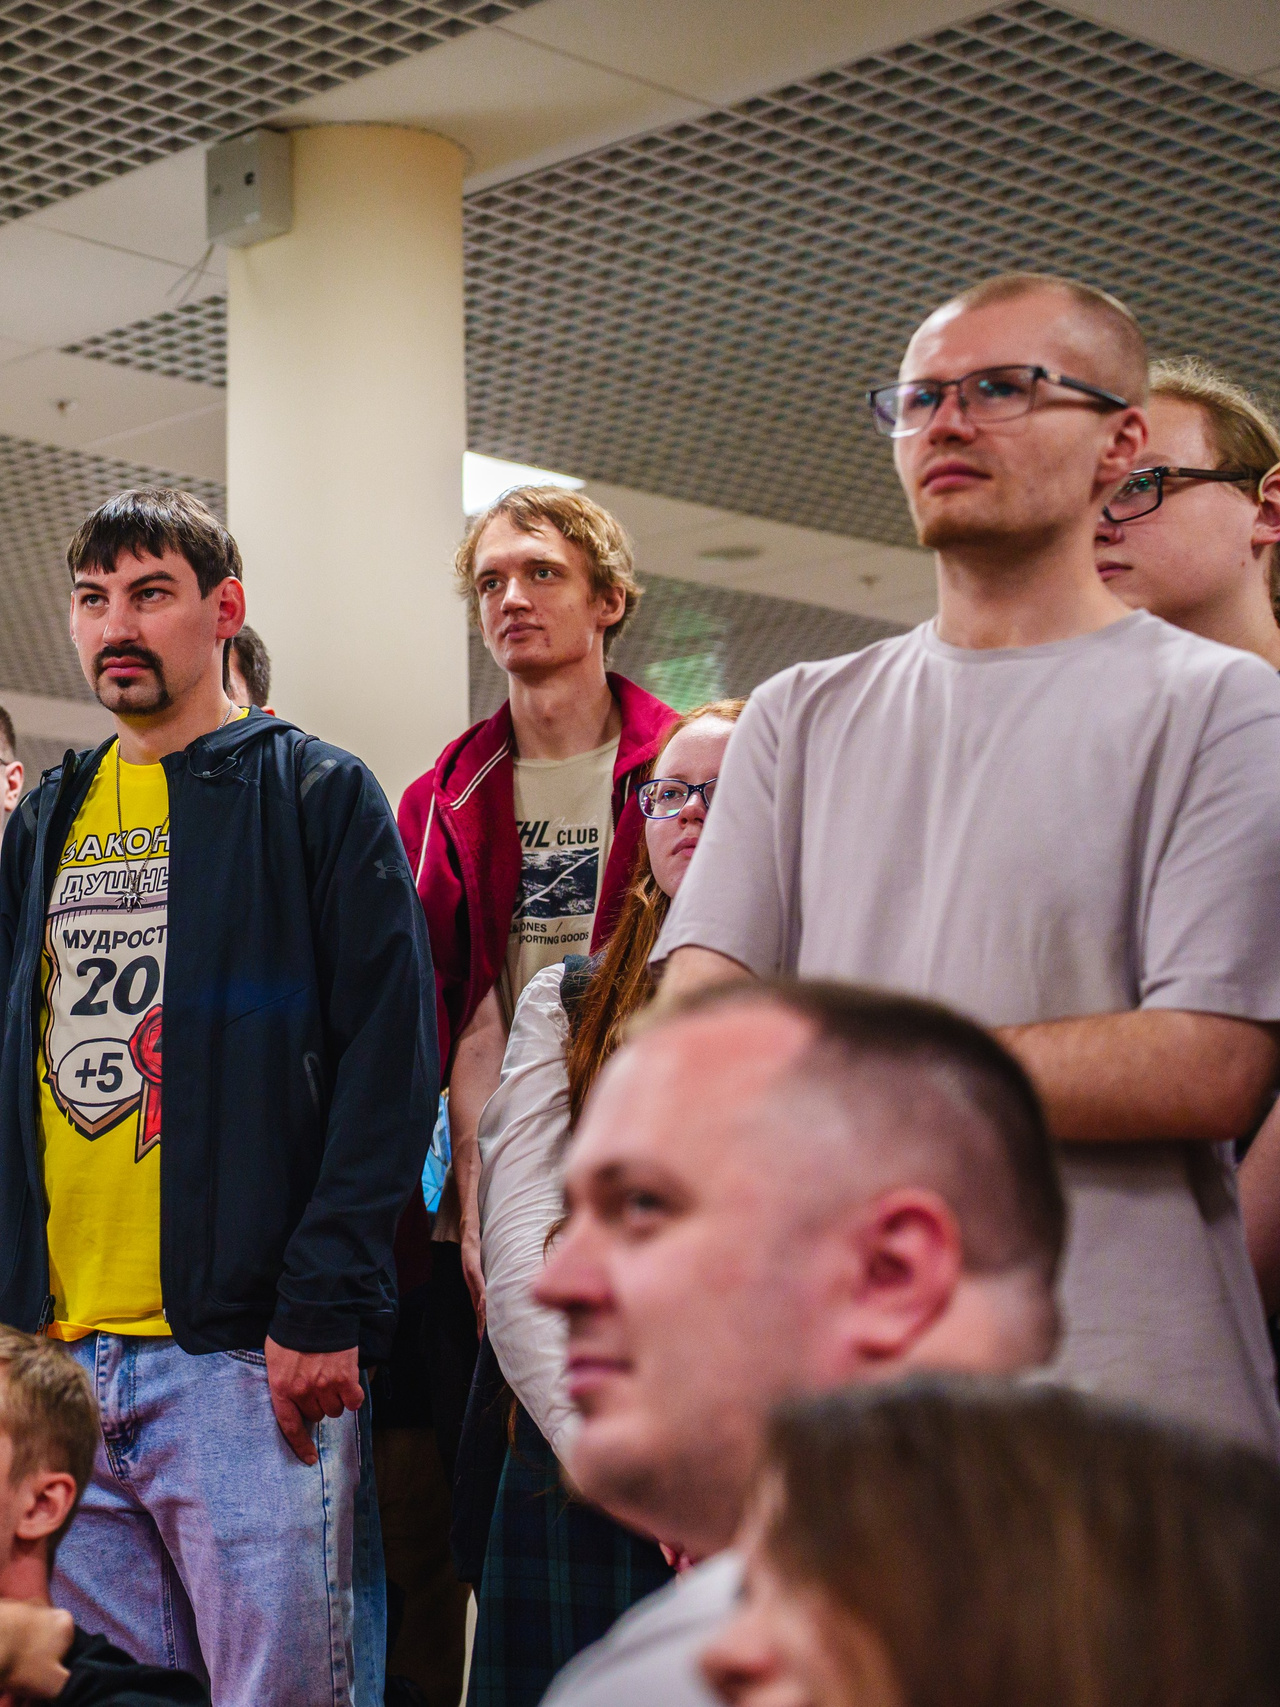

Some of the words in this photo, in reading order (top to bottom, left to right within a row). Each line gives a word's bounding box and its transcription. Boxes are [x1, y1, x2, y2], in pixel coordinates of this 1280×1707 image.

[556, 827, 599, 847] CLUB
[62, 924, 167, 954] МУДРОСТ
[560, 931, 590, 944] GOODS
[70, 954, 161, 1017] 20
[74, 1052, 124, 1094] +5
